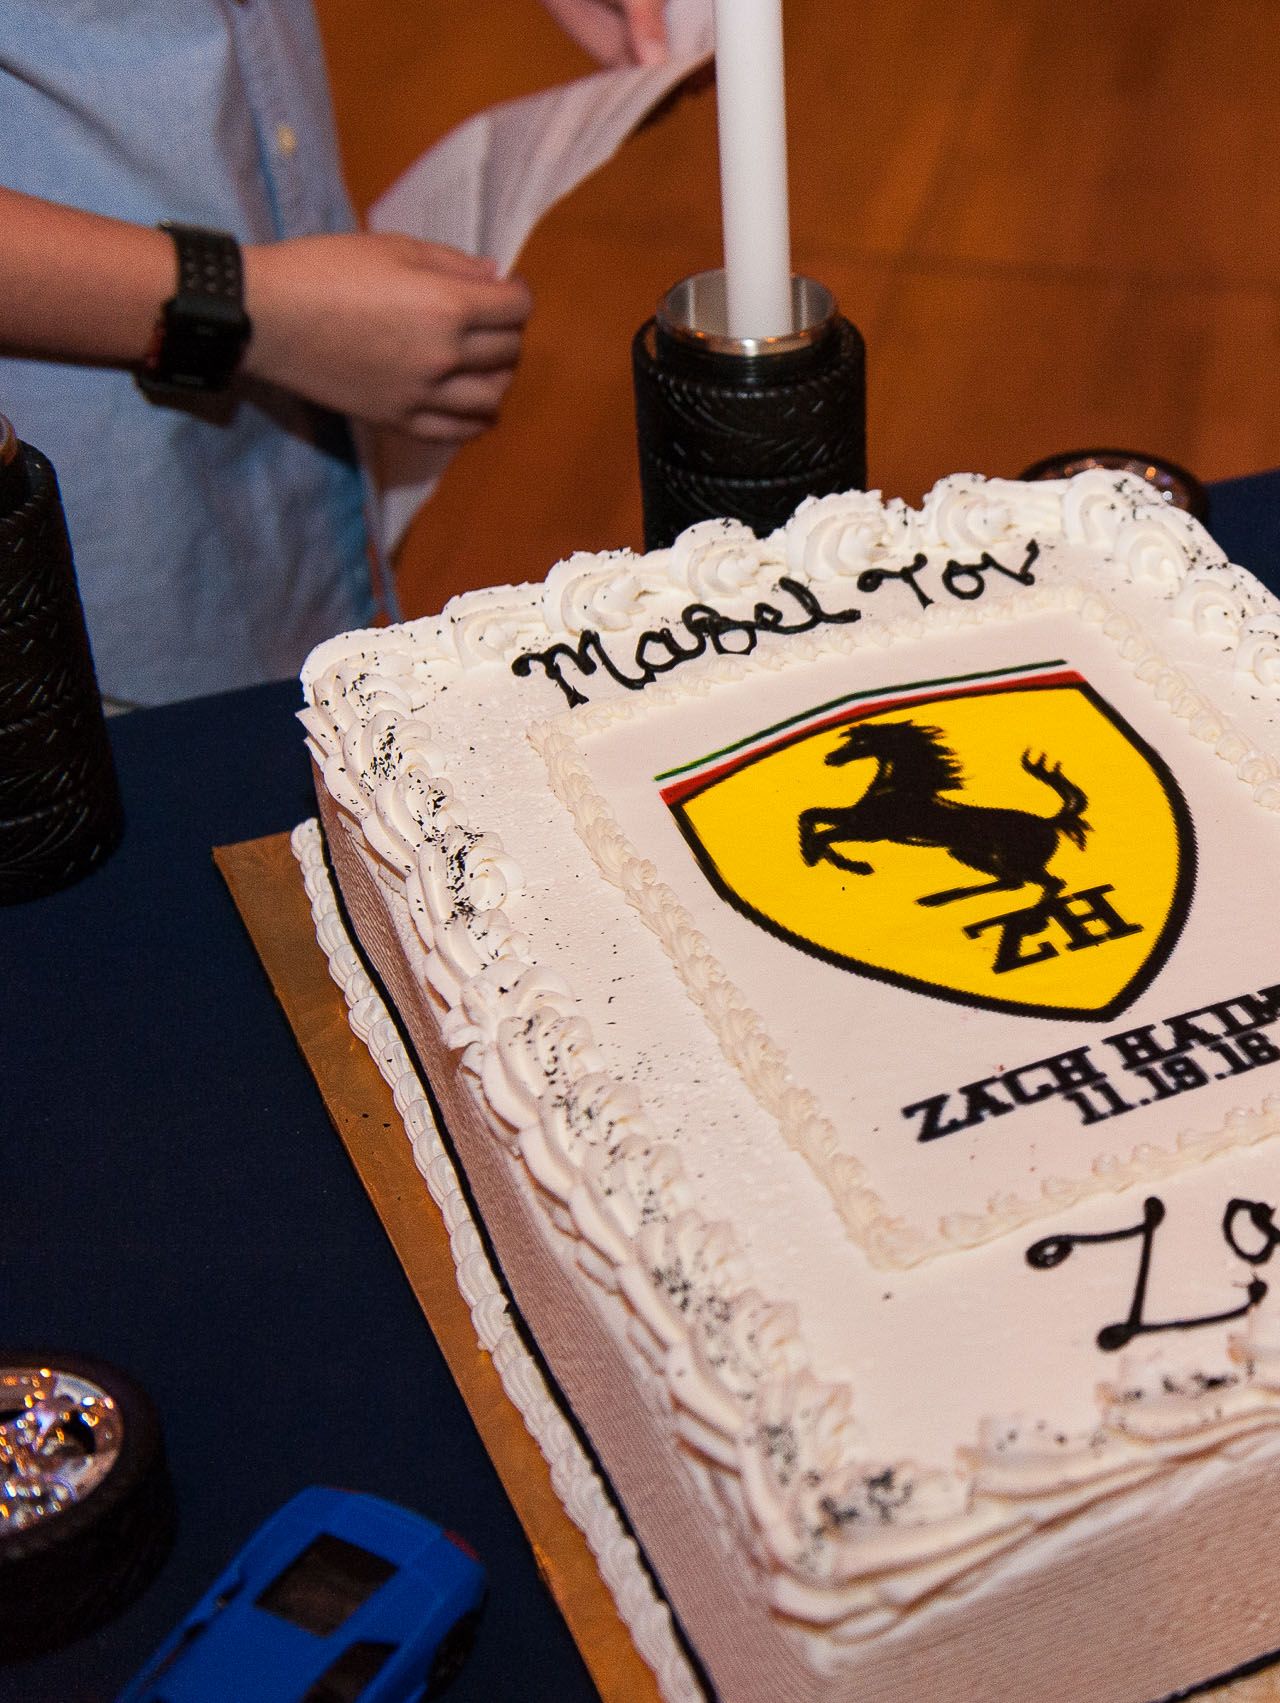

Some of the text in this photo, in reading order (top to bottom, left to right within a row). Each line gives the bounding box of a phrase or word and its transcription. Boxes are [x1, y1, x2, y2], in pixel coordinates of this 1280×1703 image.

[857, 539, 1040, 609] Tov
[962, 884, 1144, 975] ZH
[902, 1045, 1107, 1143] ZACH
